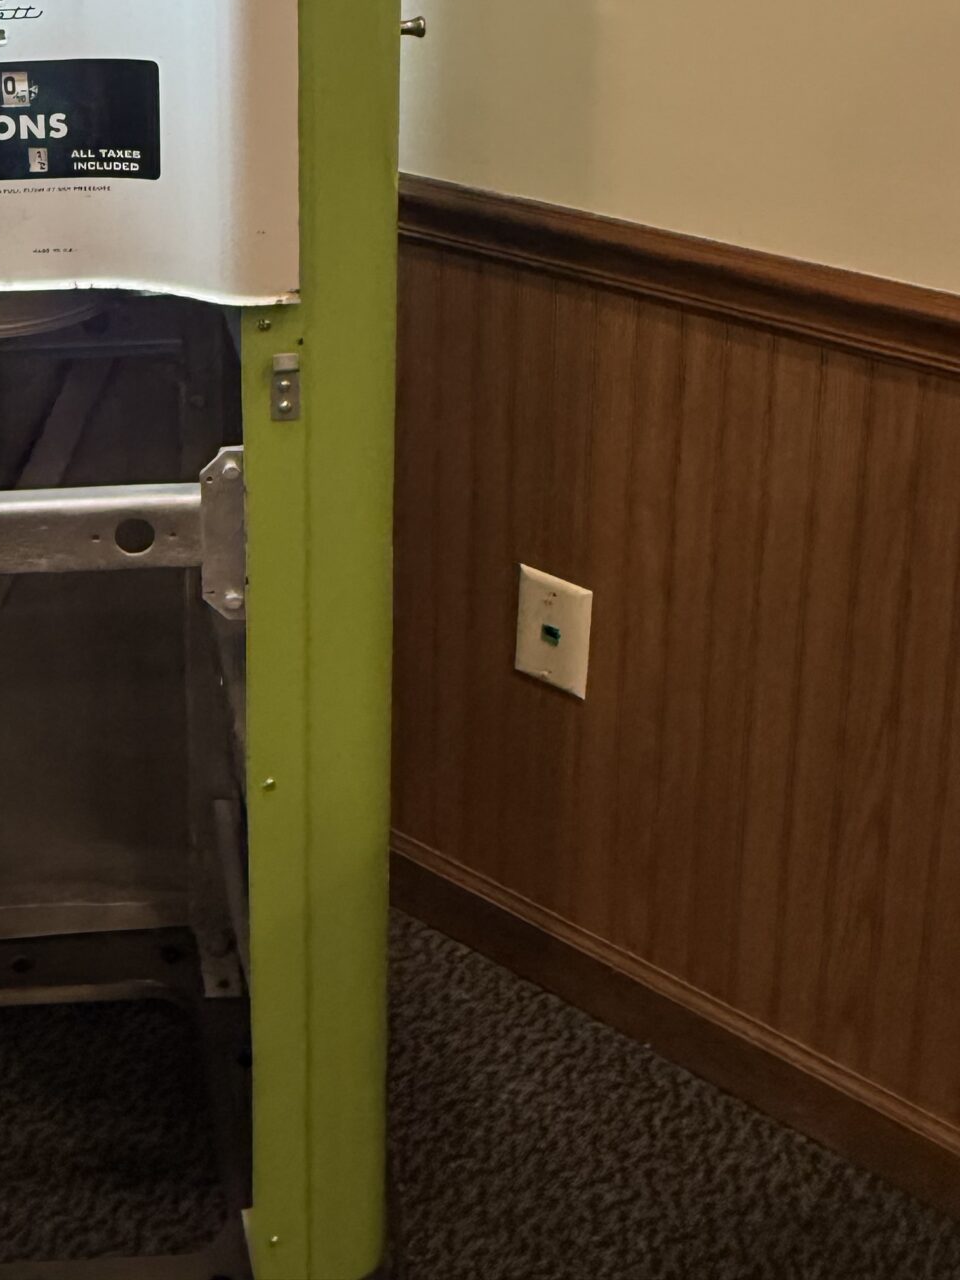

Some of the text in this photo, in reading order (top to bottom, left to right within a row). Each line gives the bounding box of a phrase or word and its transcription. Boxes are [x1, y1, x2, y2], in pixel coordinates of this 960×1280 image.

[71, 149, 142, 160] ALL TAXES
[73, 161, 141, 172] INCLUDED
